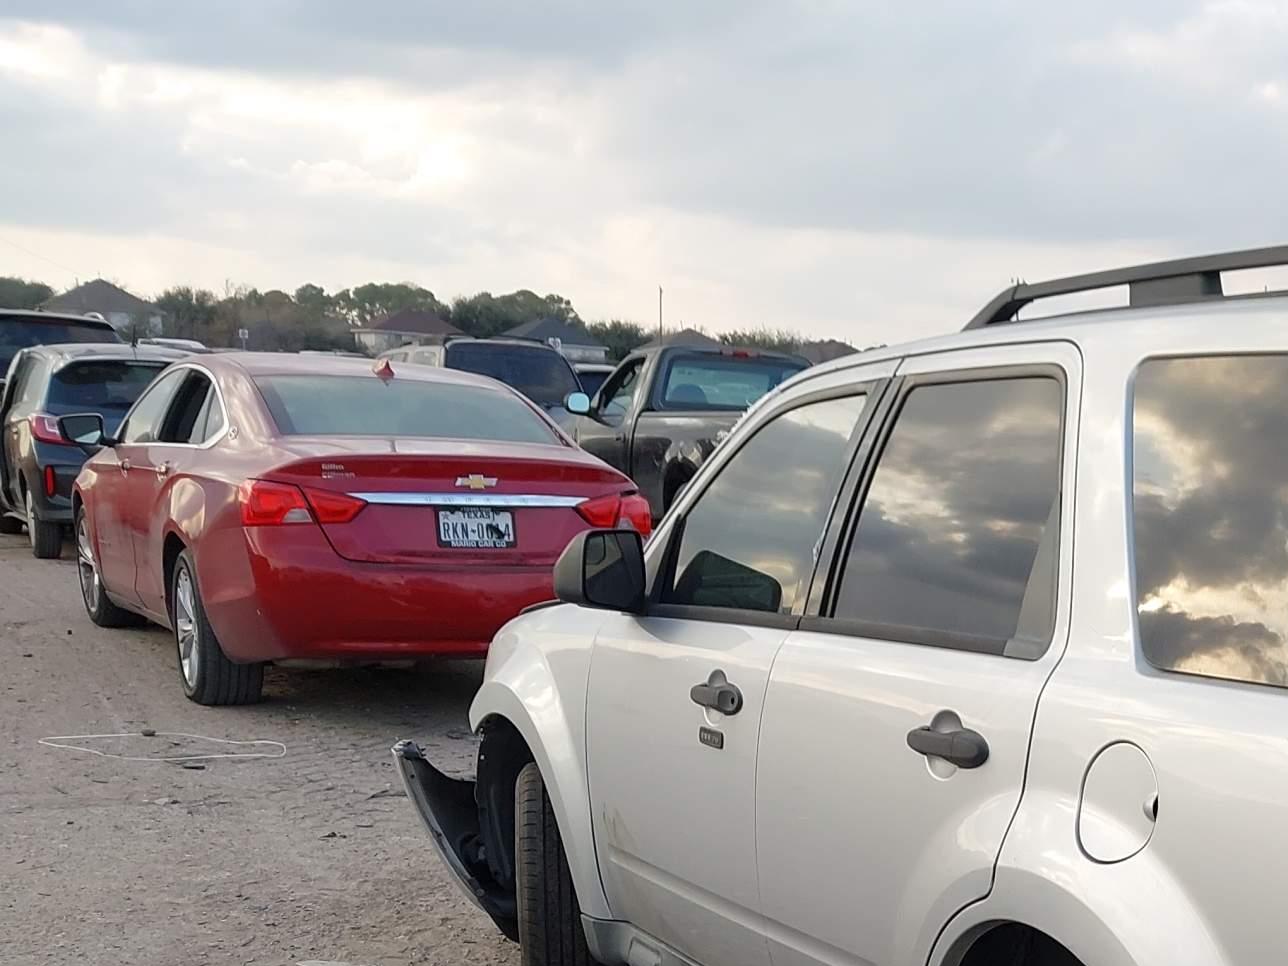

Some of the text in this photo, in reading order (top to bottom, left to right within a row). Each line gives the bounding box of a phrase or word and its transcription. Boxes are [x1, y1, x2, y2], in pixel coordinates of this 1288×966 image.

[462, 511, 491, 519] TEXAS
[443, 522, 511, 540] RKN-004
[478, 540, 494, 548] CAR
[495, 540, 507, 548] CO
